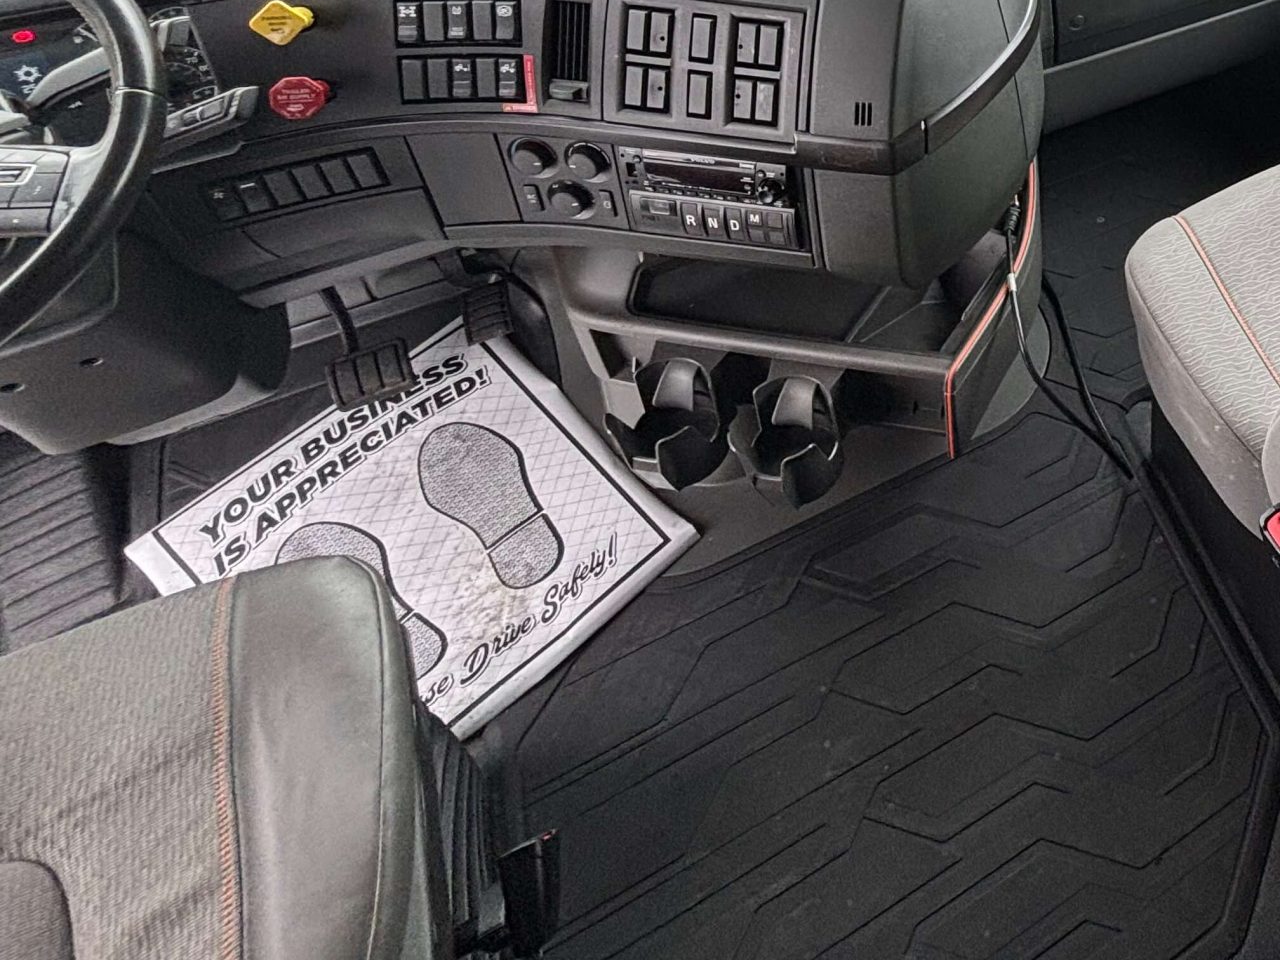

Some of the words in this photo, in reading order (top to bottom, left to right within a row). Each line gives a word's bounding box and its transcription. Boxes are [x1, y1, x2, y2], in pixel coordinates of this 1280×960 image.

[686, 215, 696, 227] R
[708, 217, 719, 229] N
[730, 219, 740, 231] D
[750, 214, 760, 223] M
[200, 458, 298, 543] YOUR
[213, 536, 249, 577] IS
[256, 366, 488, 543] APPRECIATED!
[460, 615, 536, 685] Drive
[541, 532, 617, 624] Safely!
